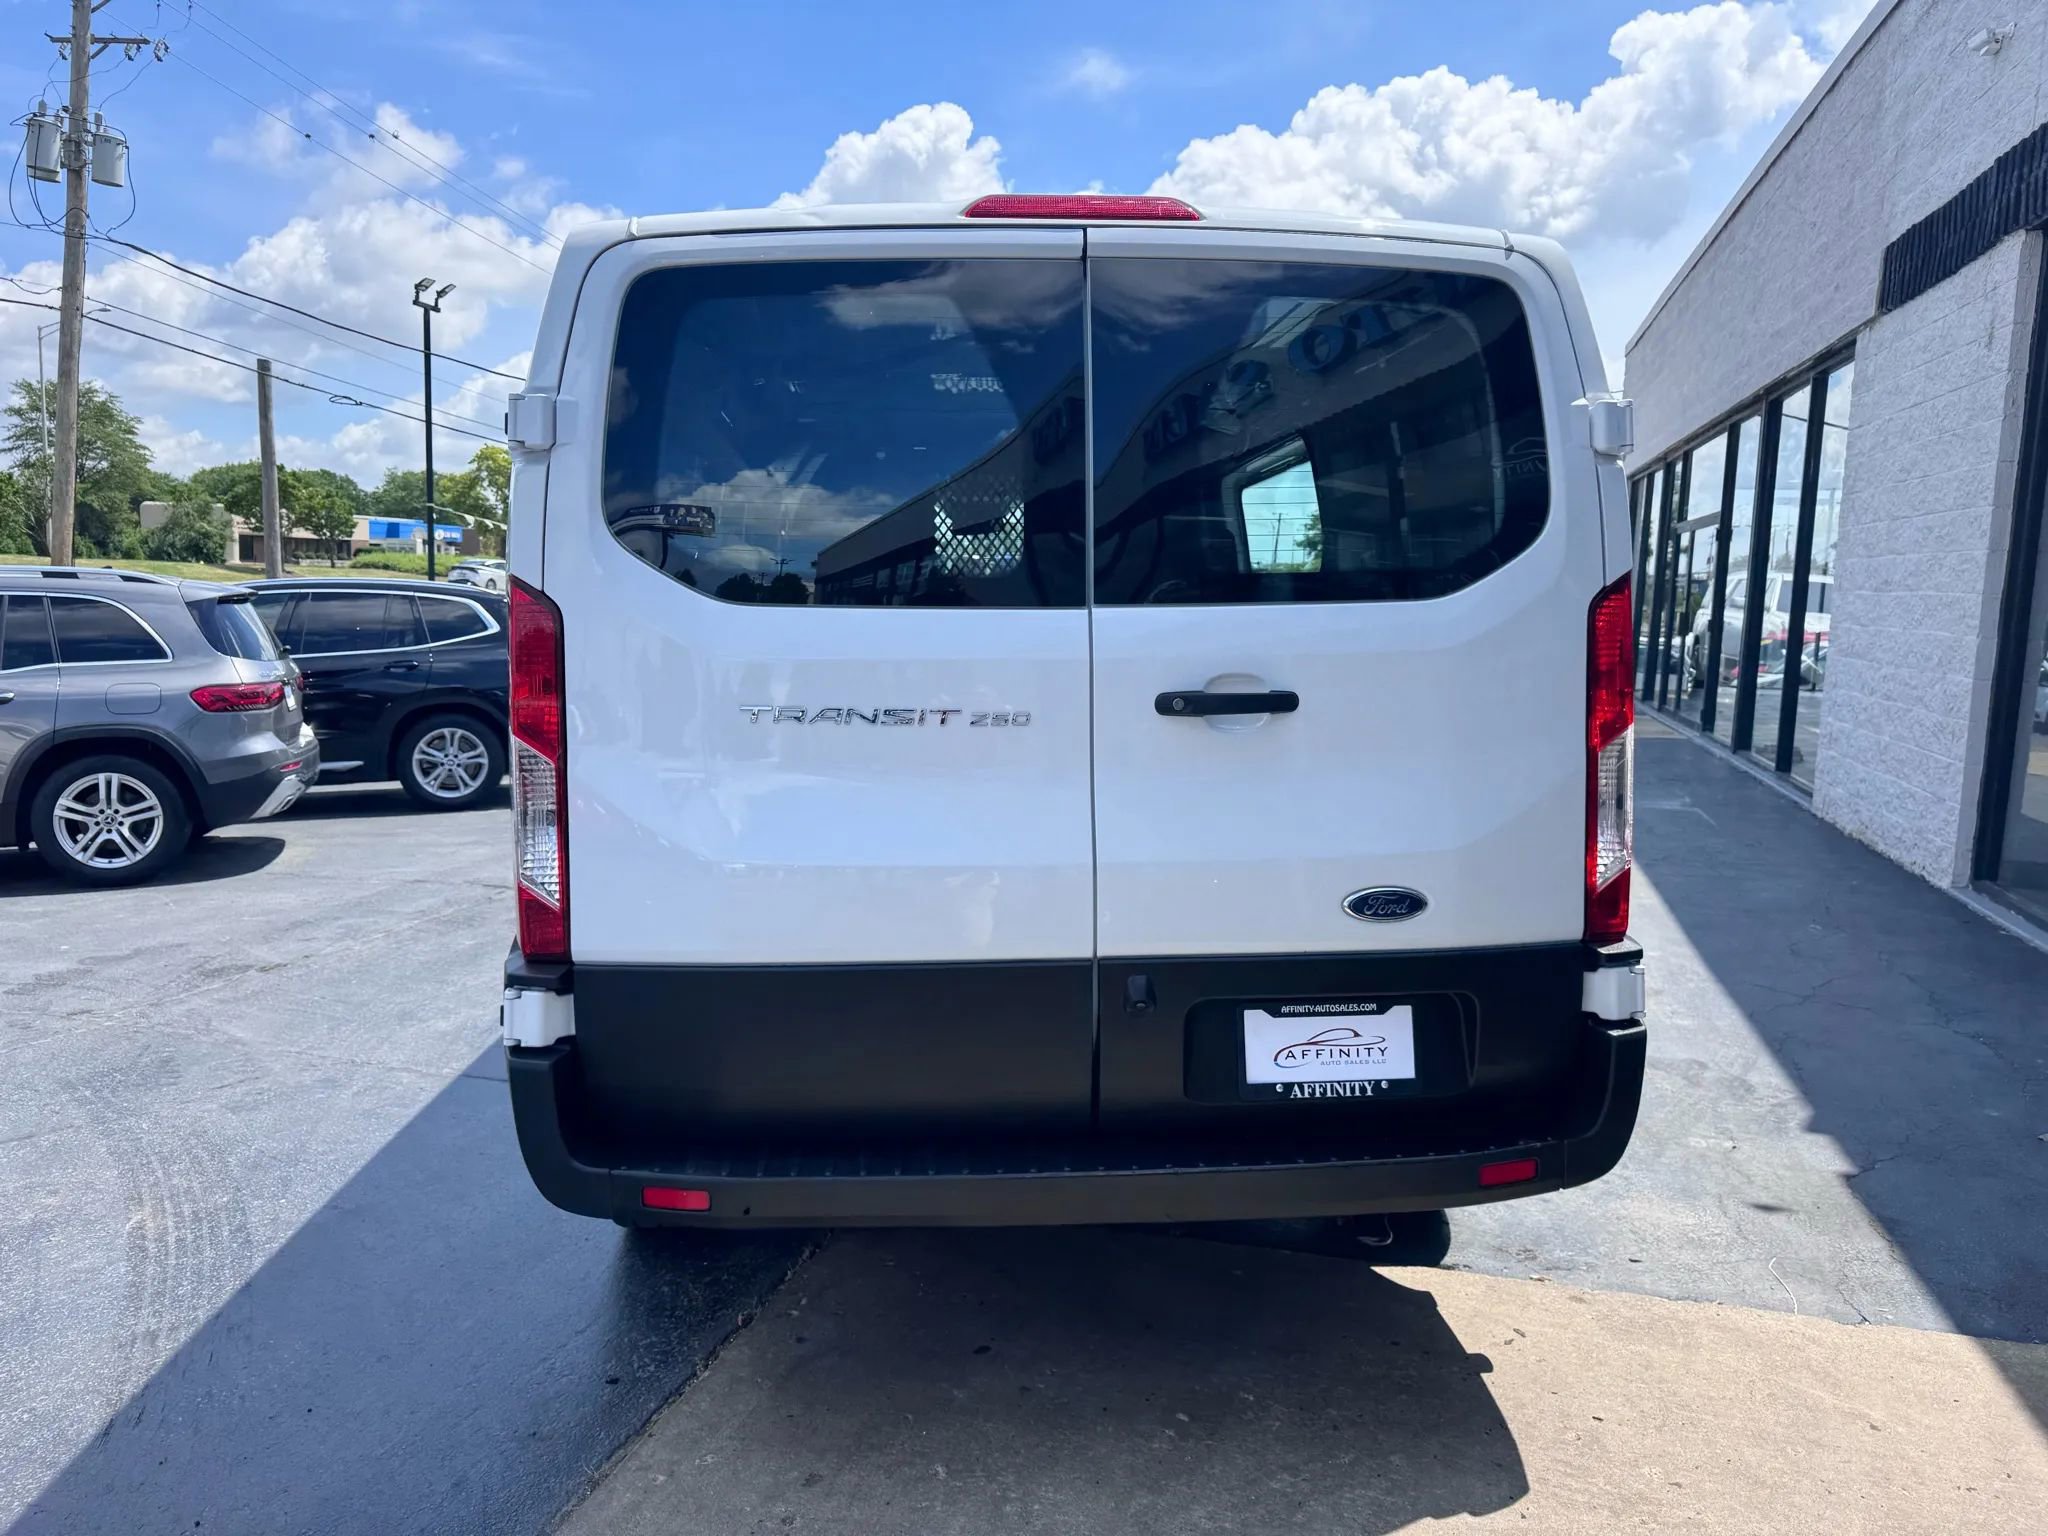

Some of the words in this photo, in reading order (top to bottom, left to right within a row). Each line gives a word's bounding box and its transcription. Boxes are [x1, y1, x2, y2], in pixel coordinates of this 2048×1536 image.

[739, 704, 962, 727] TRANSIT
[969, 712, 1032, 728] 250
[1363, 895, 1410, 915] Ford
[1281, 1003, 1377, 1014] AFFINITY-AUTOSALES.COM
[1284, 1046, 1388, 1060] AFFINITY
[1290, 1080, 1375, 1098] AFFINITY
